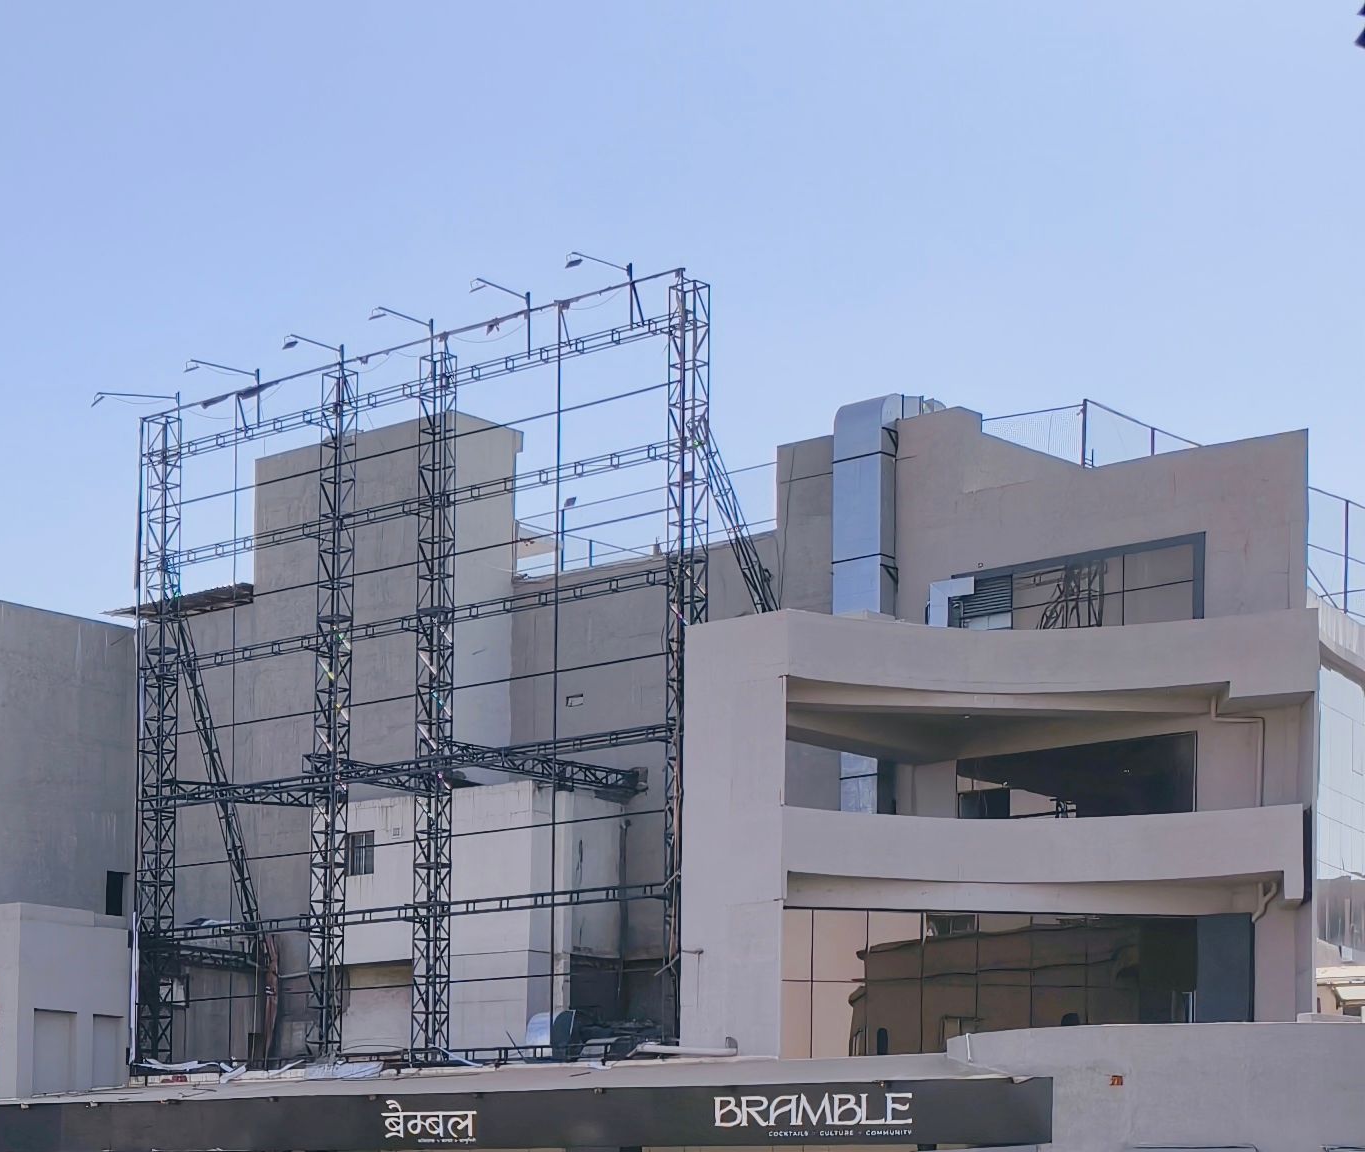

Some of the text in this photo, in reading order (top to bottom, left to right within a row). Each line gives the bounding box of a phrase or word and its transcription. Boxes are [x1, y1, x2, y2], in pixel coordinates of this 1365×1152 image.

[713, 1091, 913, 1127] BRAMBLE
[819, 1129, 854, 1137] CULTURE
[865, 1128, 913, 1136] COMMUNITY
